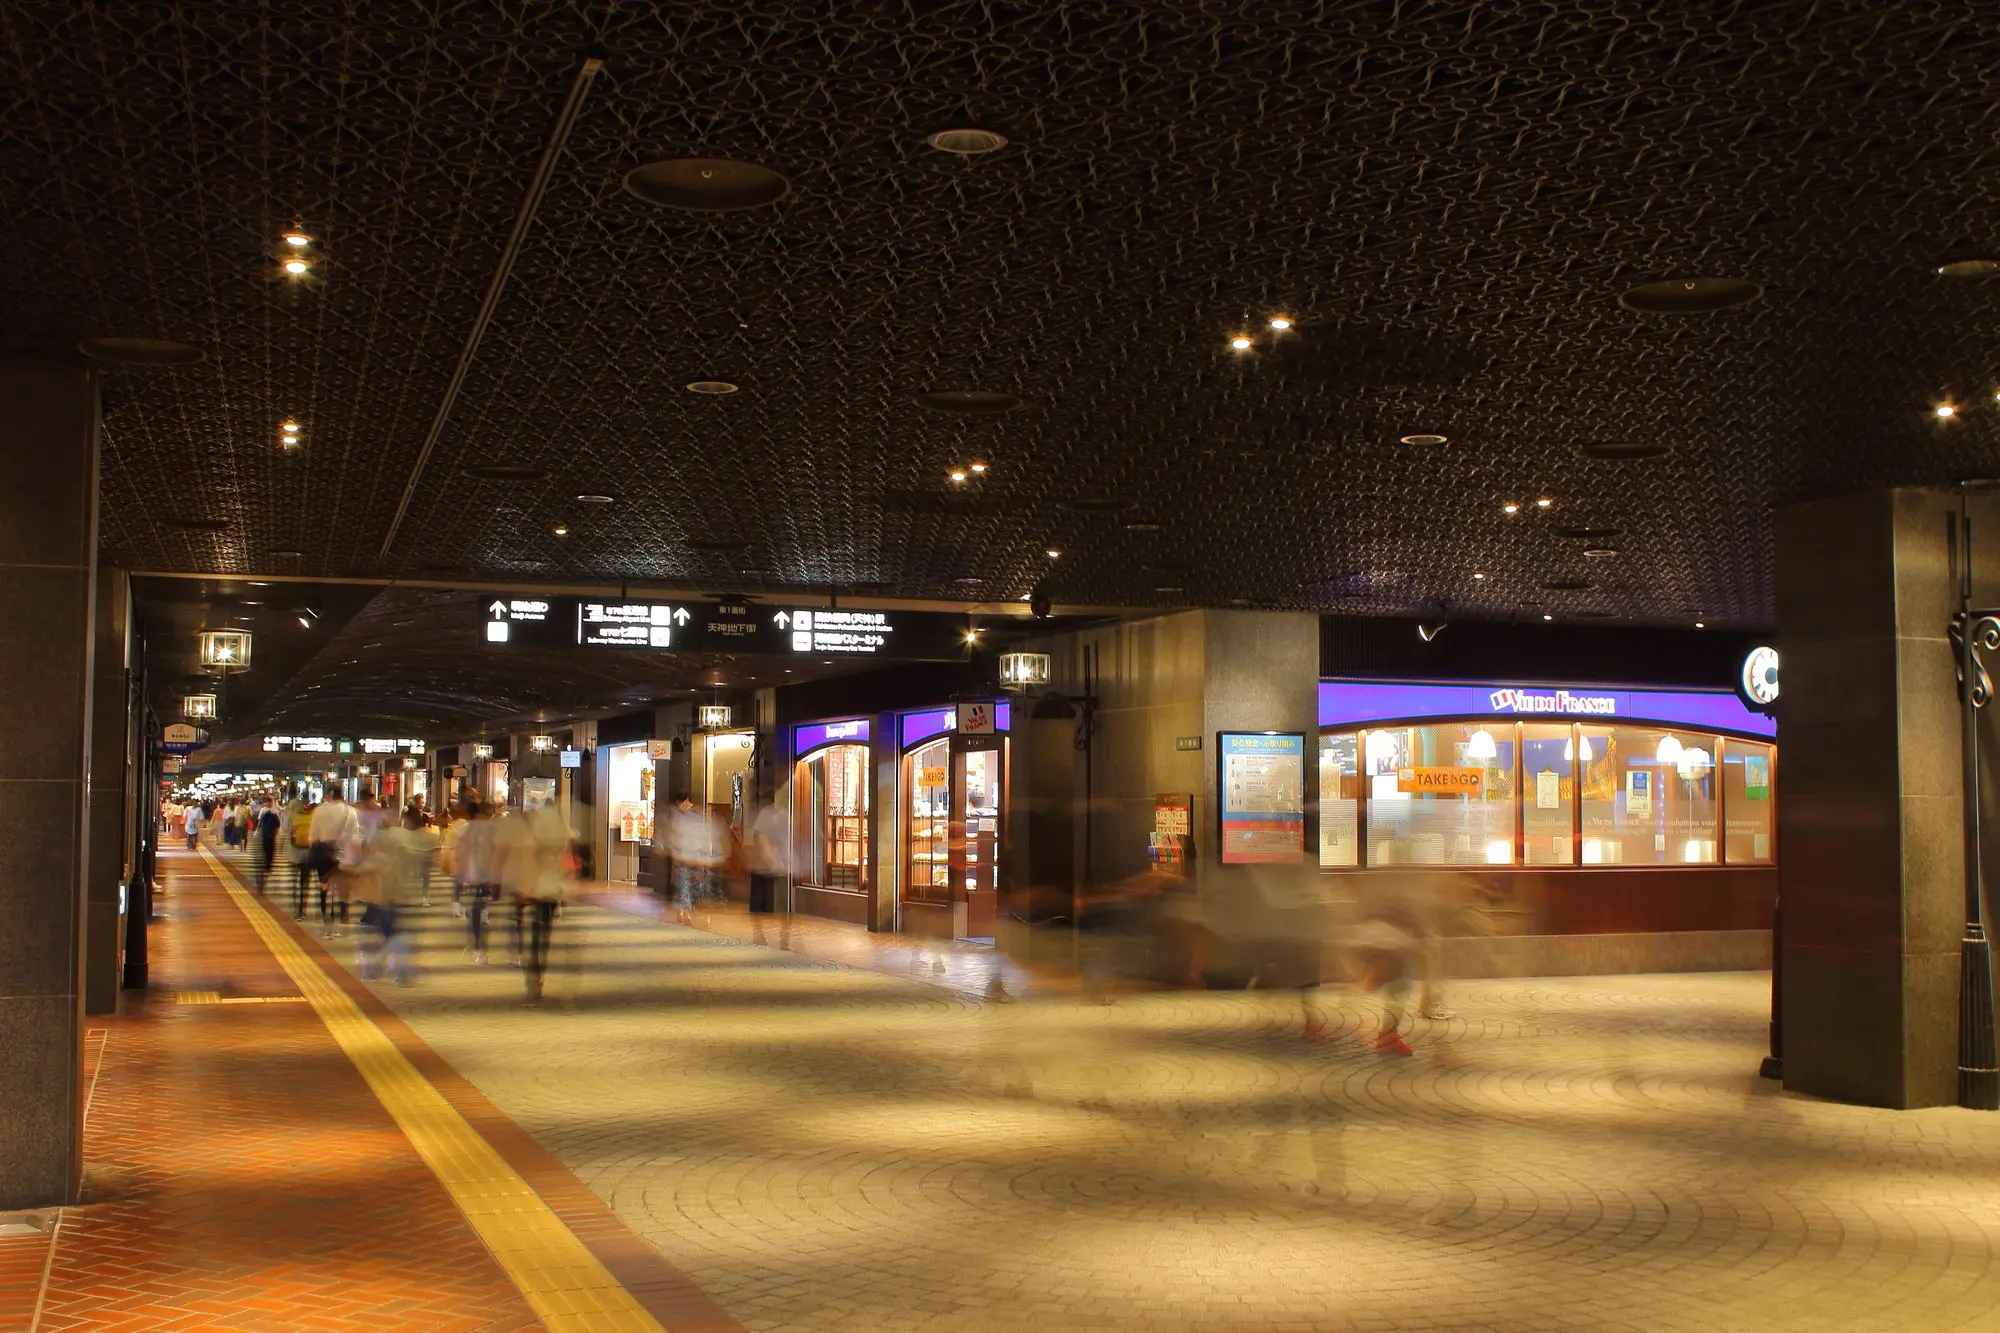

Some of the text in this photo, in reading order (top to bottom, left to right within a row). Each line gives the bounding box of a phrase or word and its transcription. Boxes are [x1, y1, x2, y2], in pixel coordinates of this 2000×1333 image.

[707, 622, 757, 633] 天神地下街
[1509, 690, 1615, 713] VIE DE FRANCE
[965, 720, 988, 732] FRANCE
[1417, 774, 1448, 785] TAKE
[1459, 774, 1479, 785] GO
